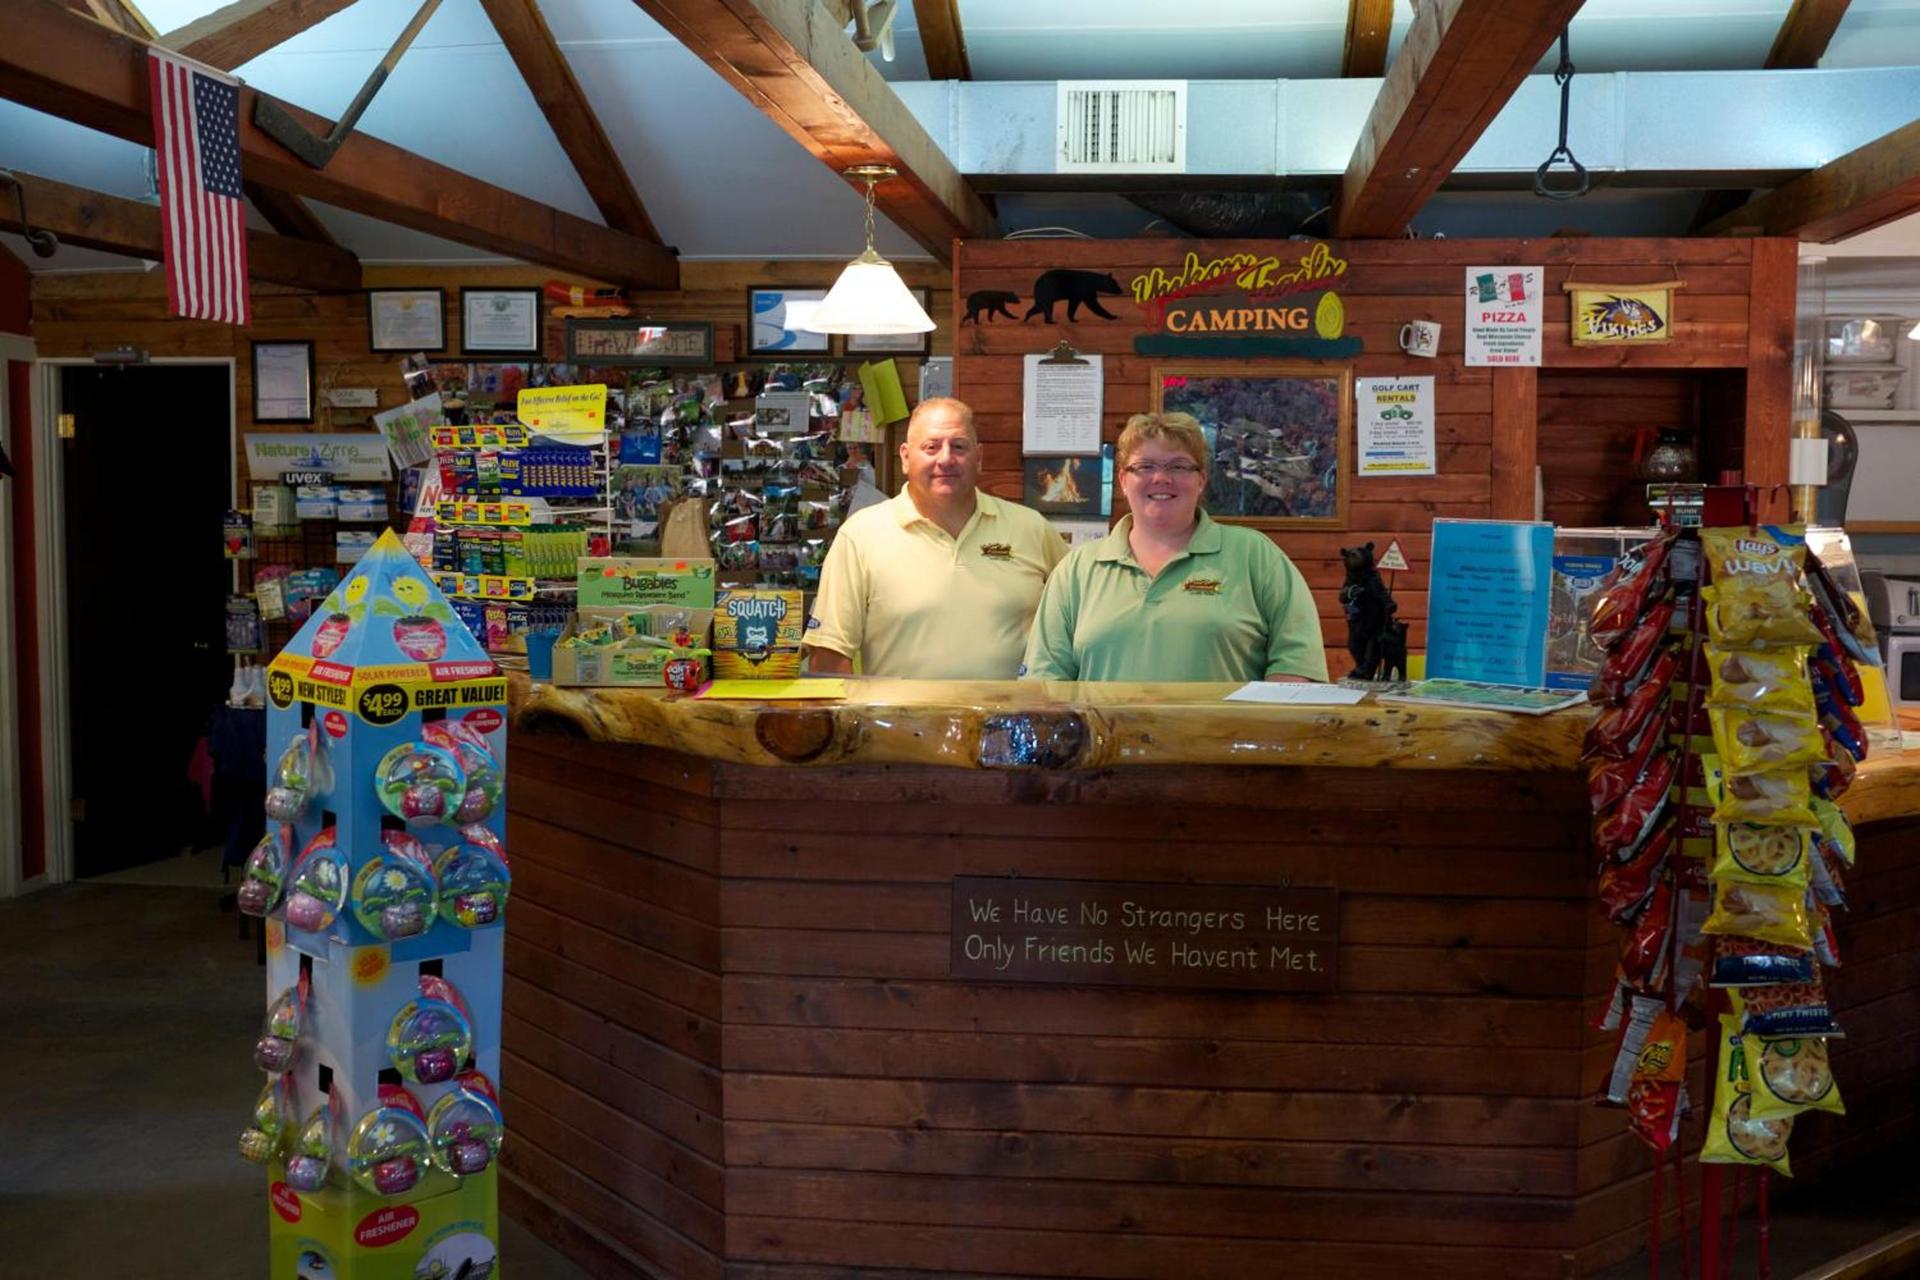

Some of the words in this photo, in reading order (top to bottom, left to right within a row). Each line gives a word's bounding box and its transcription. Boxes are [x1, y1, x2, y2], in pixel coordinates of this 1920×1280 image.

[1166, 307, 1310, 333] CAMPING
[1481, 311, 1527, 323] PIZZA
[1585, 314, 1657, 337] VIKINGS
[1371, 384, 1395, 392] GOLF
[1376, 394, 1416, 402] RENTALS
[254, 442, 310, 457] Nature
[319, 442, 360, 461] Zyme
[500, 458, 520, 469] ALEVE
[285, 472, 322, 484] uvex
[1725, 558, 1796, 576] wavy
[623, 576, 679, 591] Bugables
[485, 608, 507, 621] Pepto
[728, 597, 787, 620] SQUATCH
[507, 611, 528, 621] Zantac
[387, 667, 427, 680] POWERED
[435, 665, 450, 676] AIR
[297, 680, 315, 699] NEW
[316, 683, 347, 706] STYLES!
[415, 687, 459, 706] GREAT
[461, 684, 505, 703] VALUE!
[382, 708, 402, 716] EACH
[969, 899, 1001, 925] We
[1013, 899, 1069, 925] Have
[1080, 902, 1109, 926] No
[1120, 901, 1245, 935] Strangers
[1265, 906, 1321, 932] Here
[964, 934, 1015, 971] Only
[1024, 937, 1115, 965] Friends
[1123, 940, 1157, 965] We
[1270, 946, 1325, 973] Met.
[1791, 1007, 1829, 1017] TWISTS
[377, 1211, 396, 1225] AIR
[360, 1216, 417, 1242] FRESHENER
